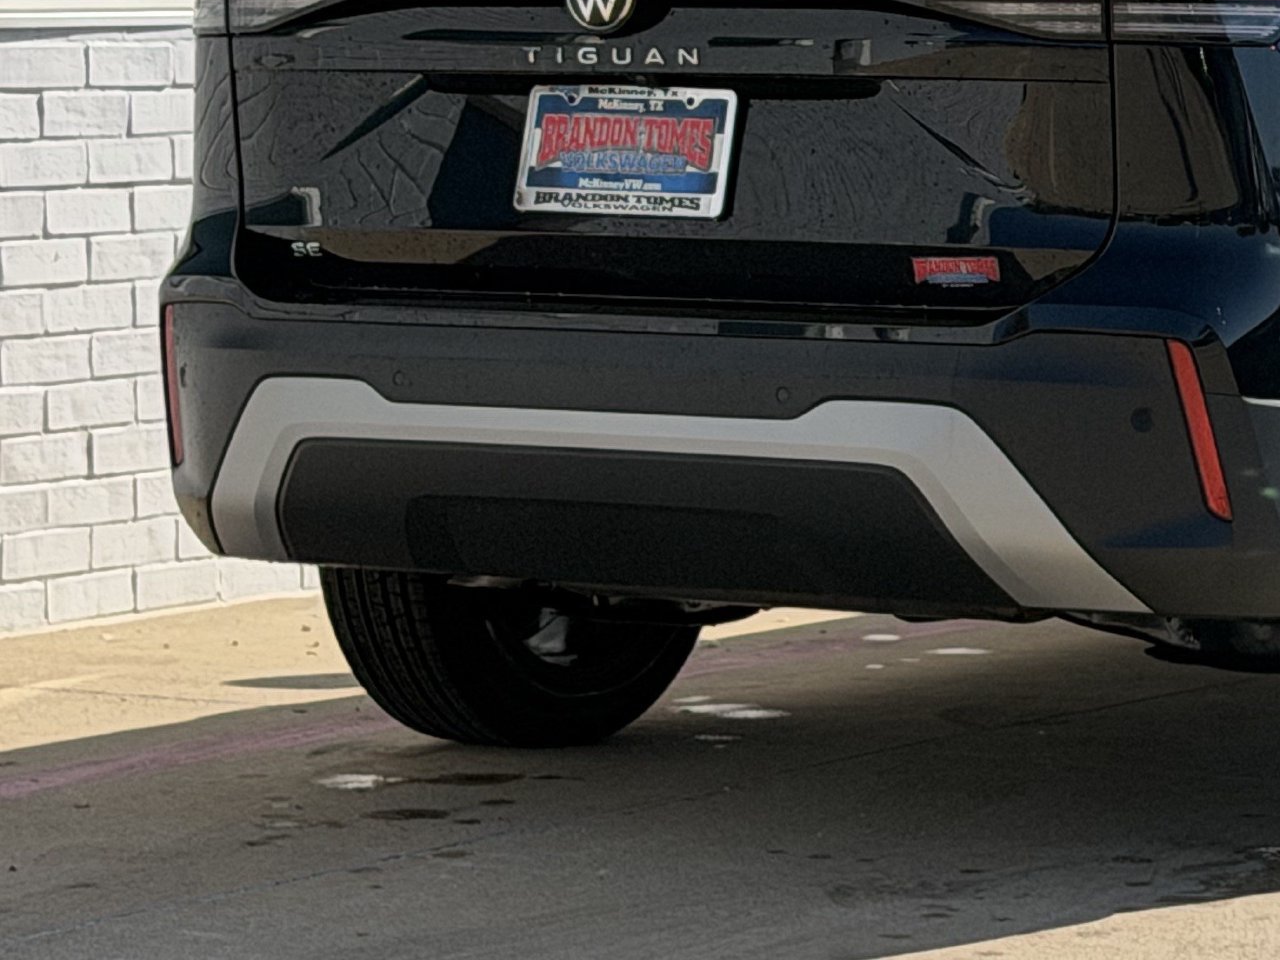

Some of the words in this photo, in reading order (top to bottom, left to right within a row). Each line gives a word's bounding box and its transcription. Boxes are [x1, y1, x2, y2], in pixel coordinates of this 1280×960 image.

[522, 46, 700, 65] TIGUAN
[649, 100, 664, 111] TX
[537, 113, 640, 167] BRANDON
[640, 117, 715, 171] TOMES
[560, 151, 688, 175] VOLKSWAGEN
[533, 191, 629, 206] BRANDON
[635, 195, 701, 211] TOMES
[560, 199, 673, 213] VOLKSWAGEN
[291, 242, 323, 257] SE
